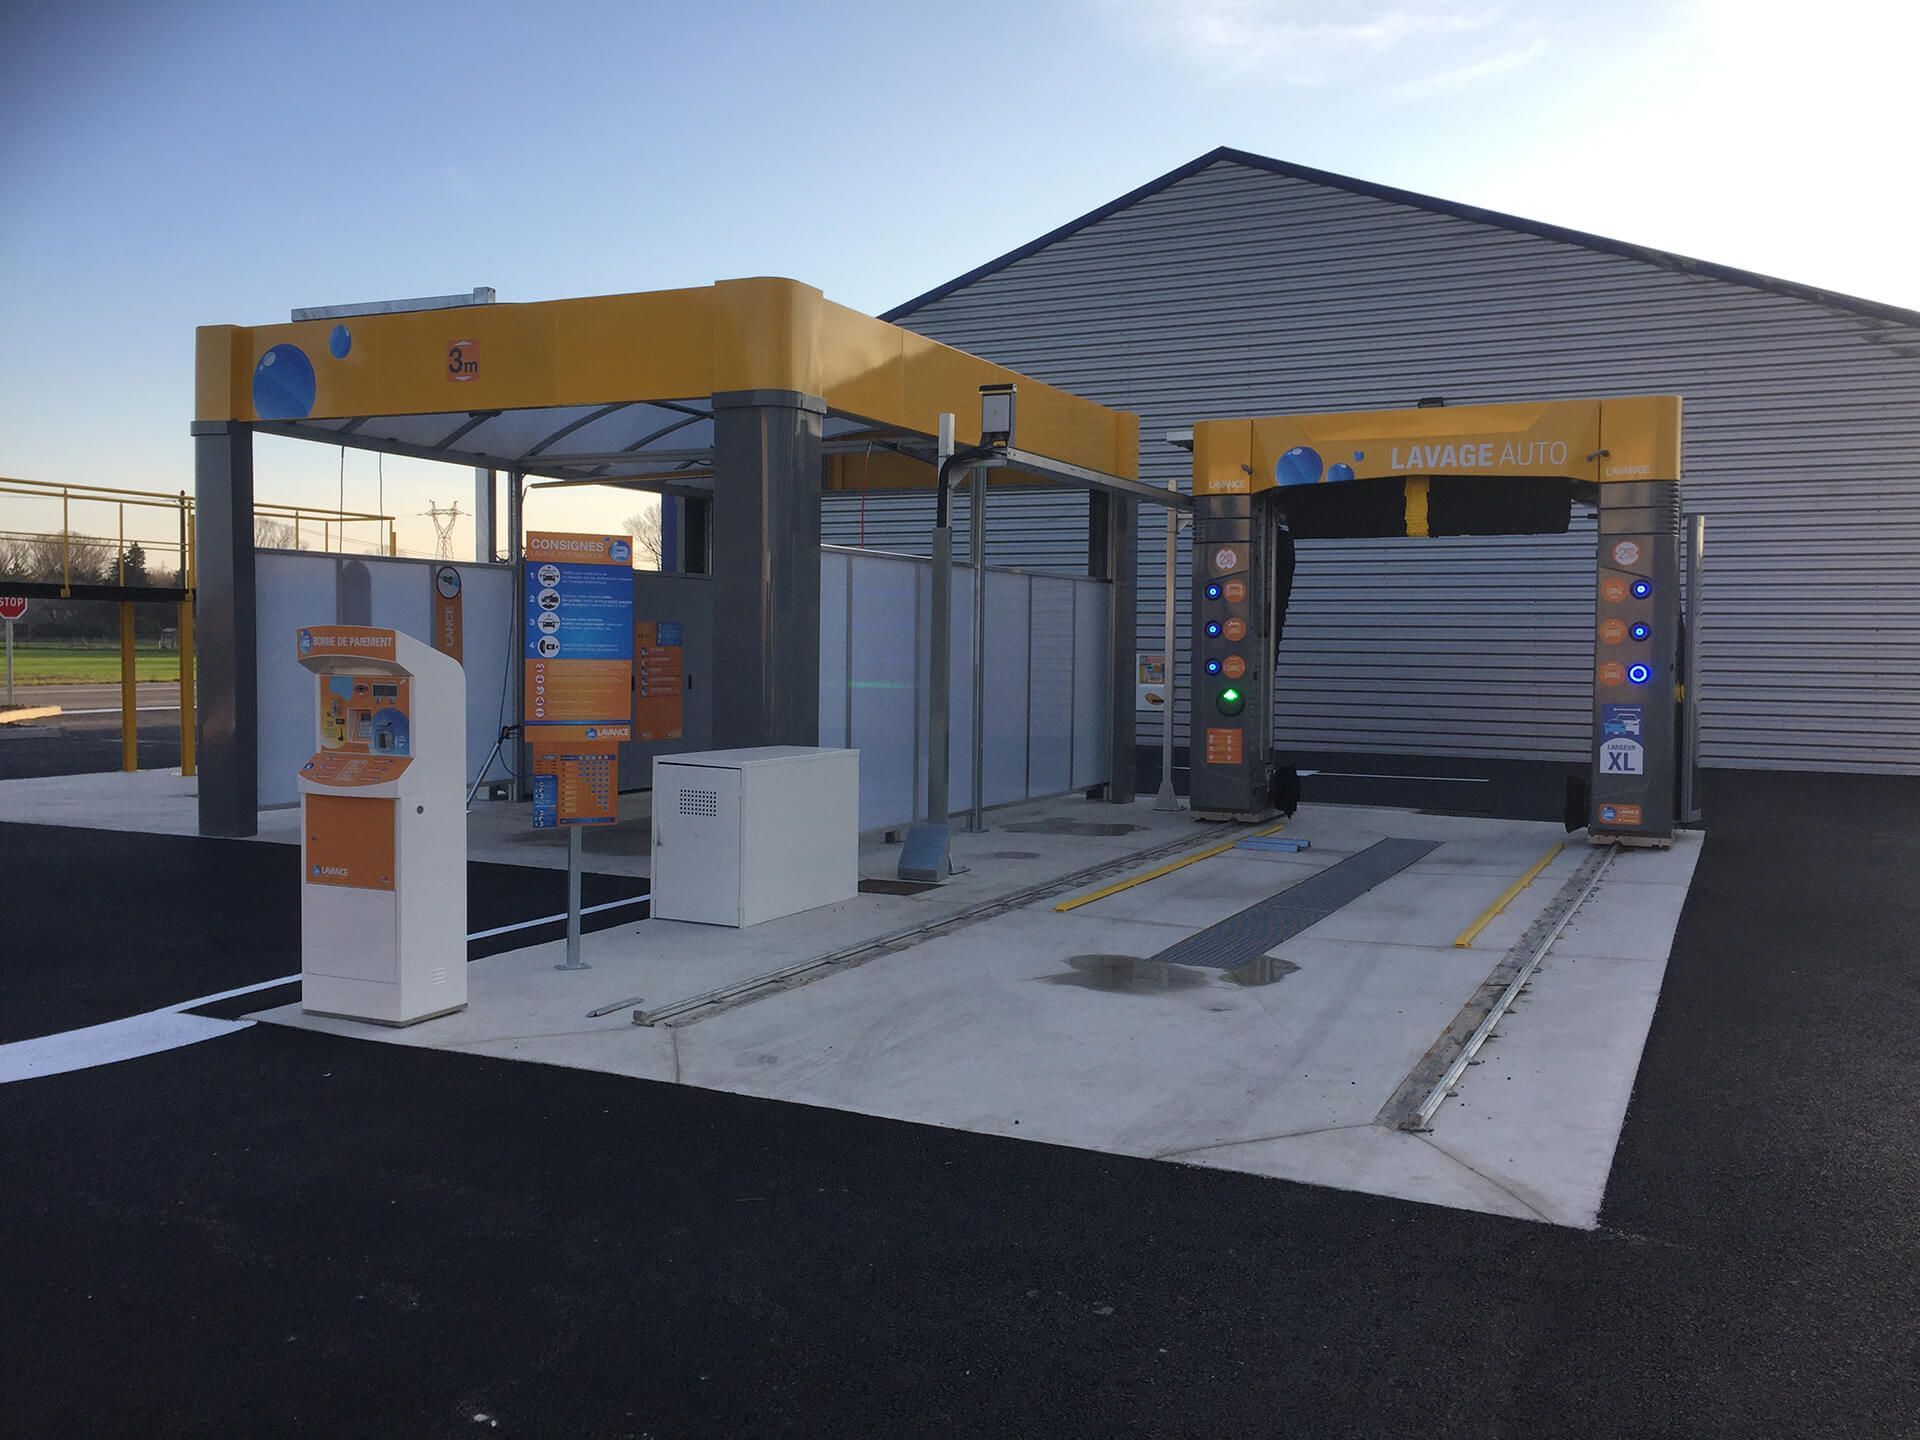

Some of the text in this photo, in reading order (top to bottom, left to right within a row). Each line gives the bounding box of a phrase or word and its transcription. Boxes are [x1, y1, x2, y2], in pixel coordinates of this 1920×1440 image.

[449, 348, 478, 373] 3m
[1391, 441, 1567, 469] LAVAGE AUTO
[1606, 465, 1649, 476] LAVANCE
[1209, 480, 1245, 489] LAVANCE
[531, 538, 604, 552] CONSIGNES
[0, 597, 24, 607] STOP
[529, 595, 536, 603] 2
[445, 607, 454, 647] LANCE
[313, 636, 393, 648] BORNE DE PAIEMENT
[597, 728, 630, 737] LAVANCE
[1607, 752, 1635, 771] XL
[321, 866, 348, 877] LAVANCE
